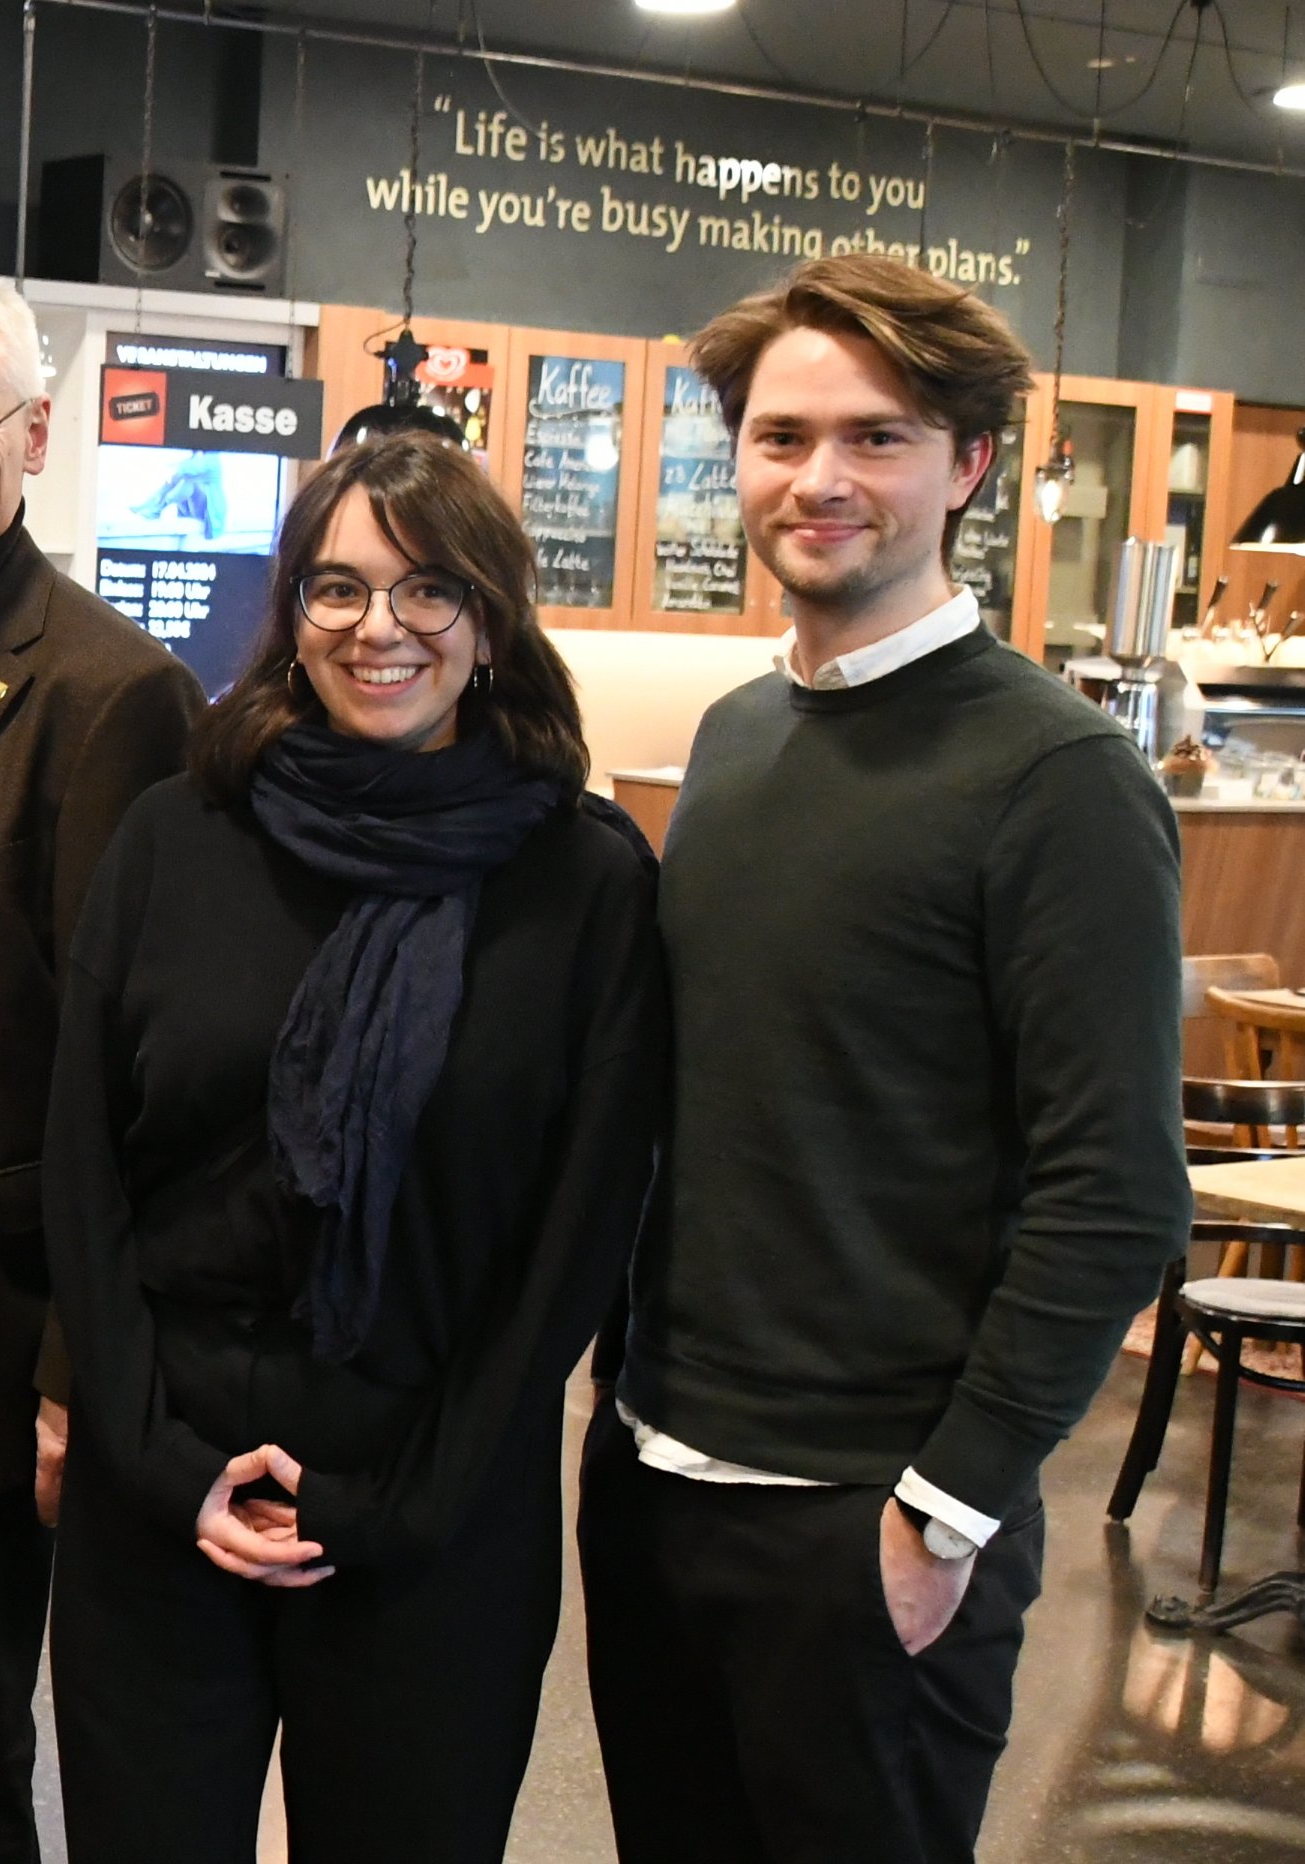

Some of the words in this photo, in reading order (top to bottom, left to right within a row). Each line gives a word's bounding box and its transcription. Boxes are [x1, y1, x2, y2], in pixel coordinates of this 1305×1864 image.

[539, 120, 566, 164] is
[575, 129, 665, 176] what
[675, 141, 819, 204] happens
[828, 162, 863, 201] to
[867, 172, 925, 216] you
[365, 171, 469, 220] while
[600, 186, 689, 253] busy
[698, 210, 823, 261] making
[116, 401, 153, 415] TICKET
[189, 394, 298, 436] Kasse
[537, 361, 613, 410] Kaffee
